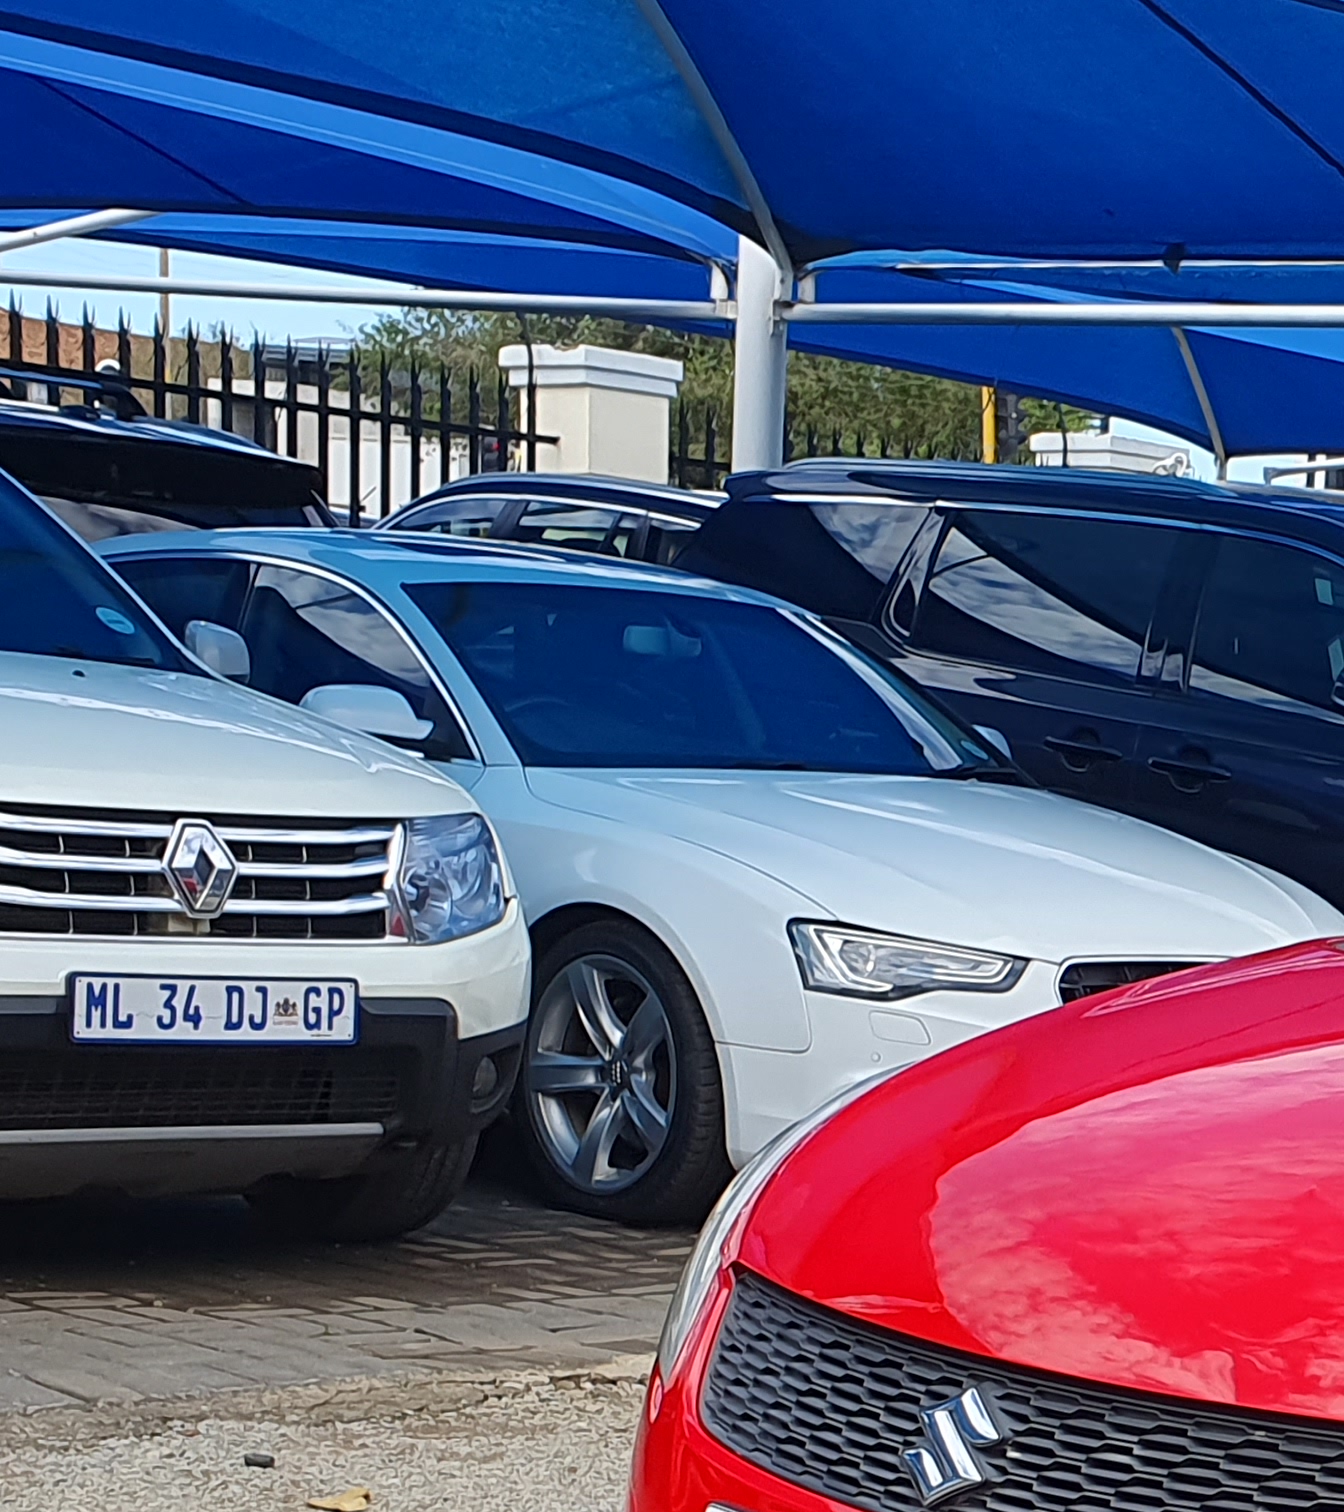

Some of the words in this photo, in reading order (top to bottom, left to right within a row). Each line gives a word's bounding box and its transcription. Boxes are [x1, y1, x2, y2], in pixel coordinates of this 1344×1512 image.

[85, 981, 134, 1030] ML
[156, 983, 203, 1031] 34
[223, 985, 268, 1031] DJ
[303, 986, 345, 1031] GP
